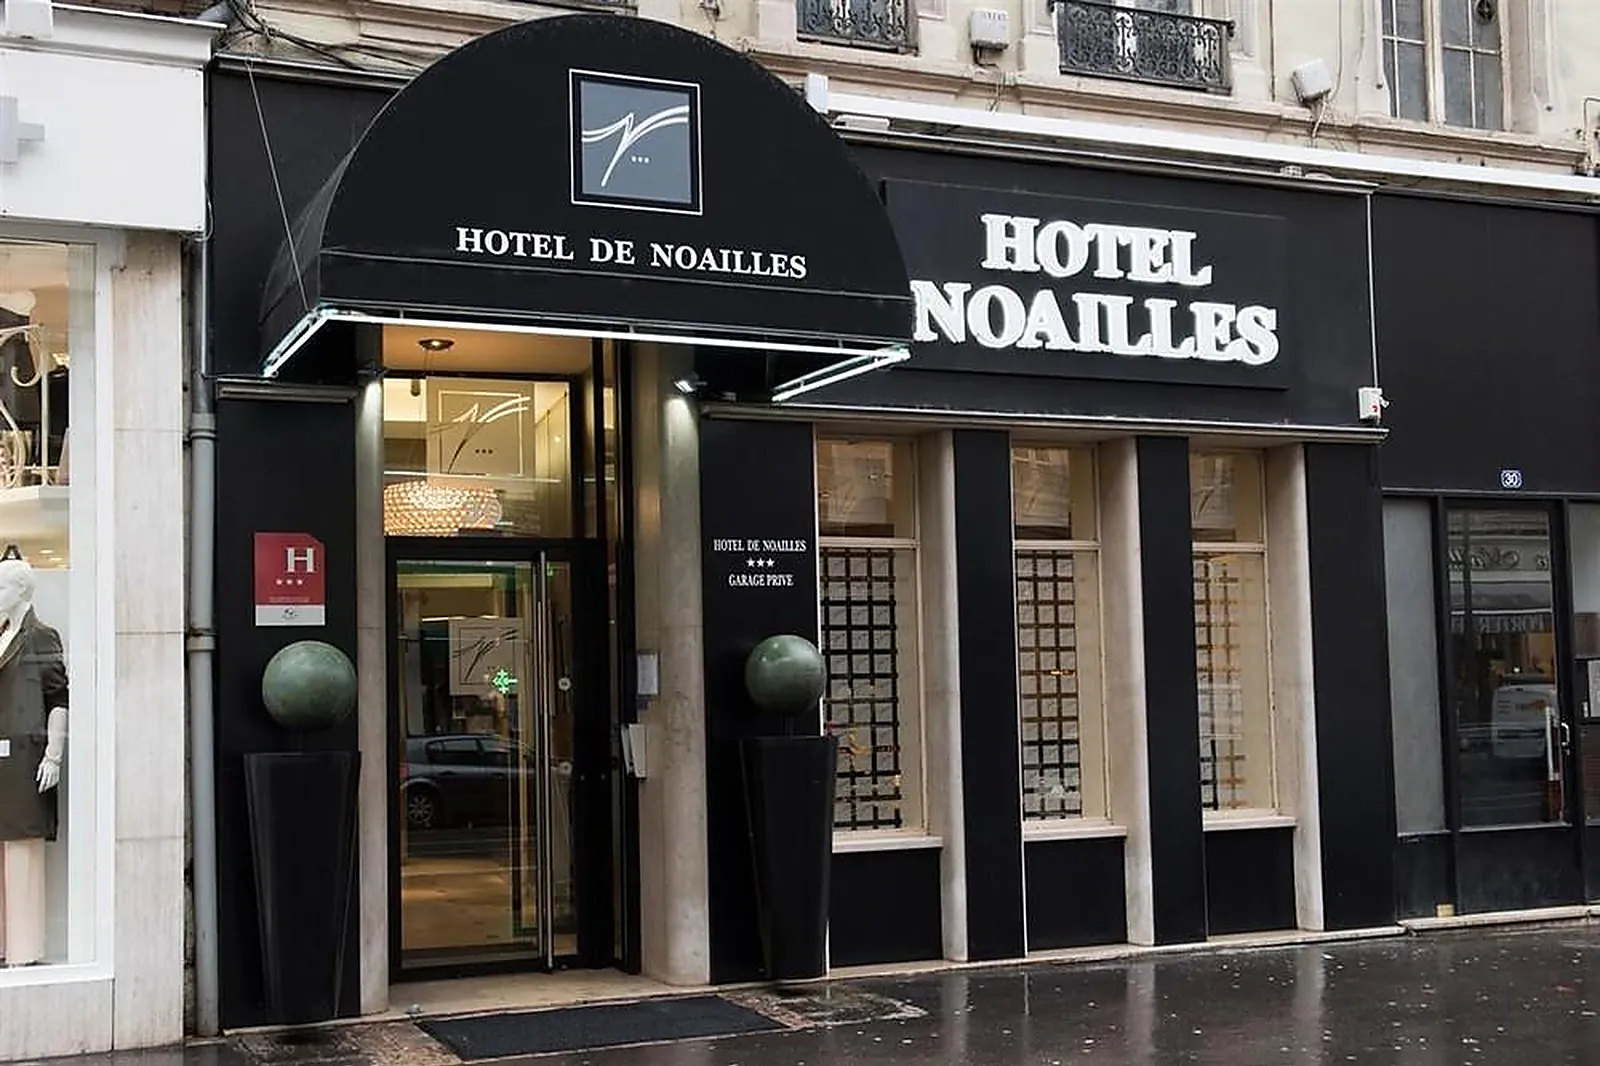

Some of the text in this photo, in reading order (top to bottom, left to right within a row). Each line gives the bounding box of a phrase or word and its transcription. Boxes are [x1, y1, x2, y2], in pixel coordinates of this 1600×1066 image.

[455, 226, 808, 279] HOTEL DE NOAILLES
[980, 213, 1213, 286] HOTEL
[909, 279, 1280, 366] NOAILLES
[286, 547, 315, 573] H
[713, 538, 807, 552] HOTEL DE NOAILLES
[728, 573, 766, 587] GARAGE
